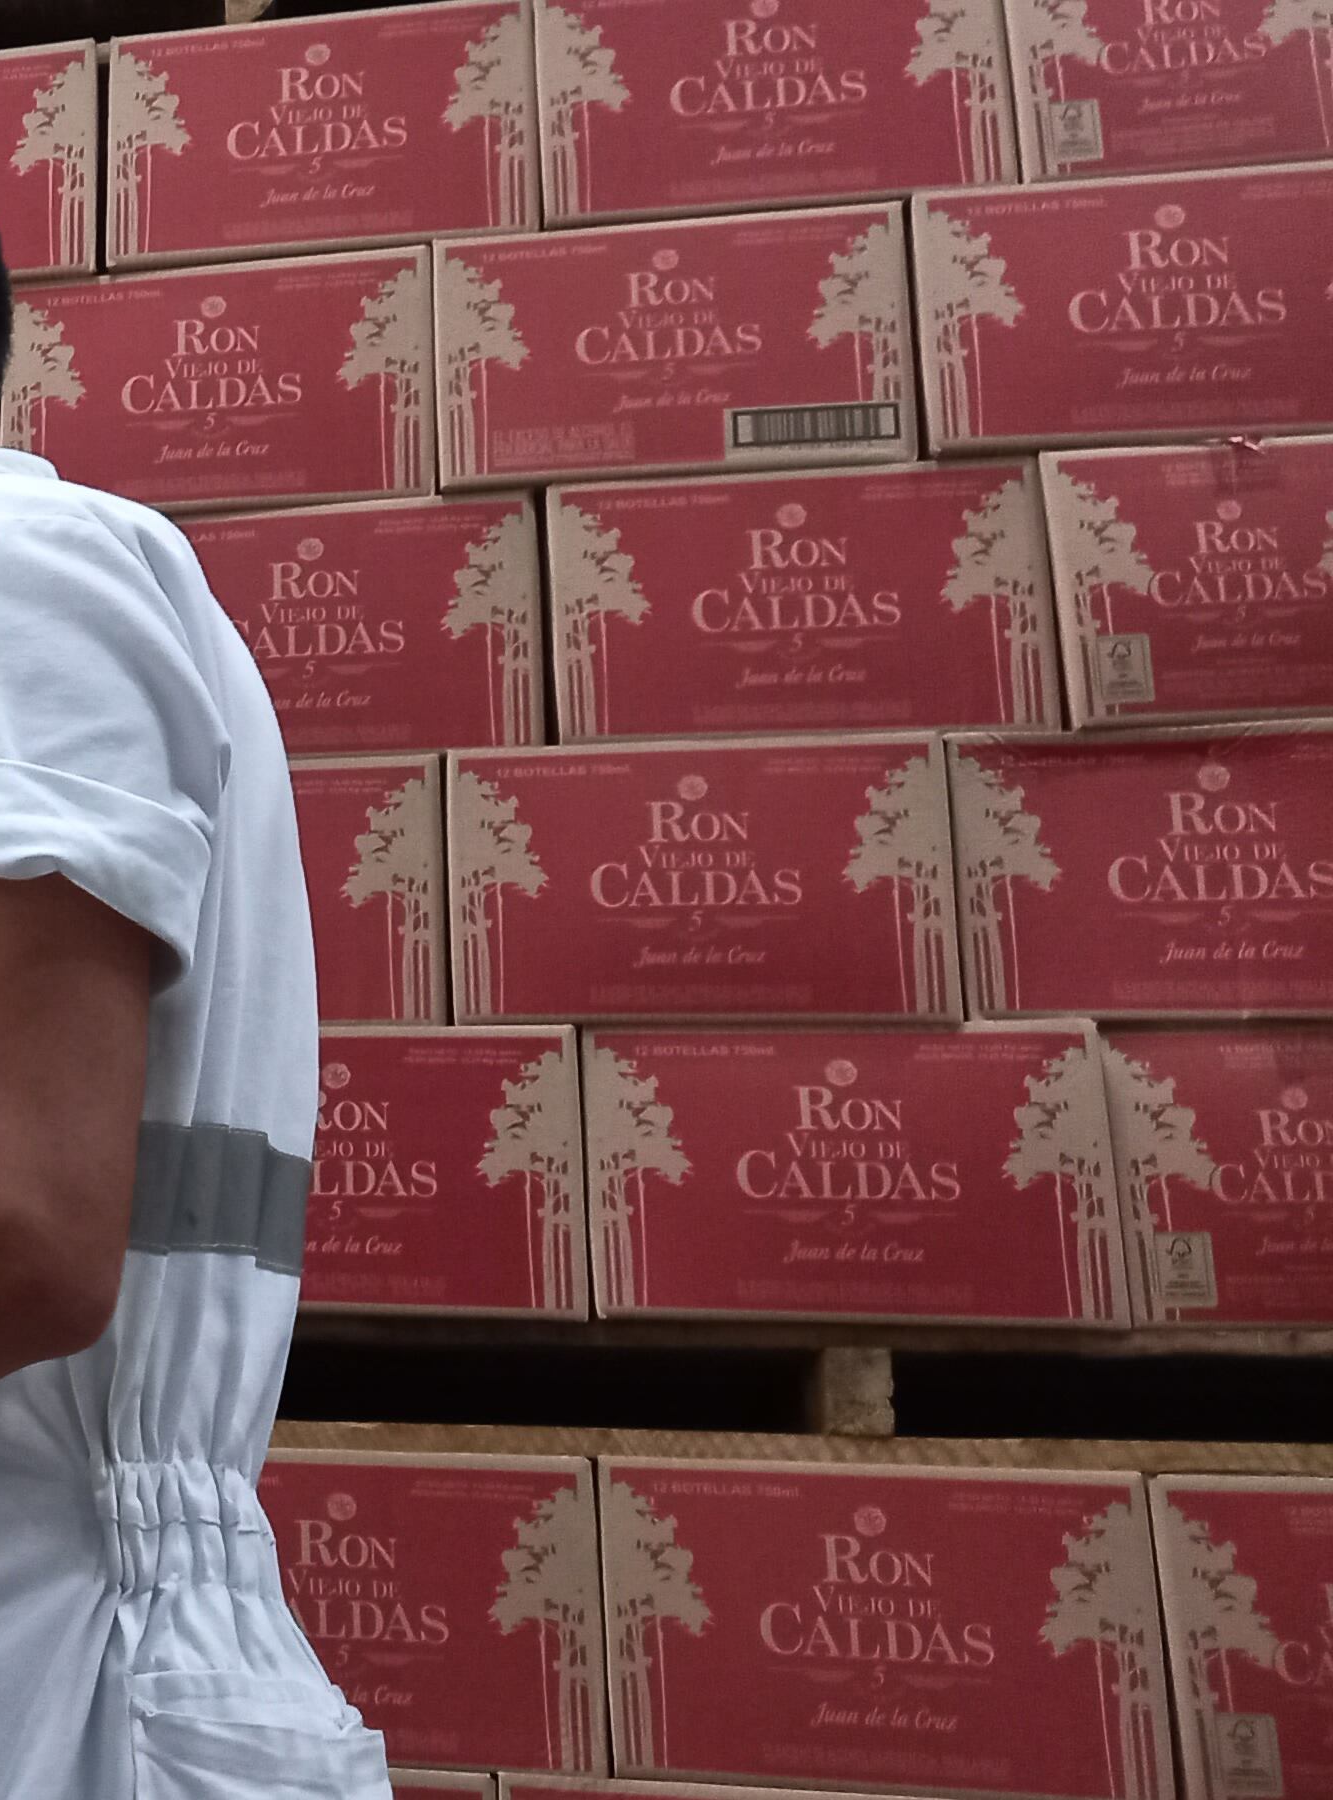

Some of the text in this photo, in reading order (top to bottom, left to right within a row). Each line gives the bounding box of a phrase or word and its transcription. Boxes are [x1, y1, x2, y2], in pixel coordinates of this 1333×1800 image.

[725, 19, 817, 56] RON
[277, 66, 365, 102] RON
[669, 69, 868, 117] CALDAS
[226, 116, 408, 161] CALDAS
[1123, 229, 1229, 270] RON
[626, 272, 714, 308] RON
[1068, 287, 1288, 334] CALDAS
[173, 318, 260, 357] RON
[575, 323, 762, 365] CALDAS
[121, 373, 302, 415] CALDAS
[746, 529, 849, 570] RON
[269, 561, 360, 601] RON
[692, 588, 901, 634] CALDAS
[646, 800, 749, 843] RON
[1164, 791, 1277, 836] RON
[590, 863, 803, 907] CALDAS
[1108, 856, 1333, 901] CALDAS
[794, 1085, 901, 1131] RON
[737, 1150, 962, 1201] CALDAS
[295, 1519, 397, 1569] RON
[819, 1533, 934, 1586] RON
[760, 1602, 995, 1666] CALDAS
